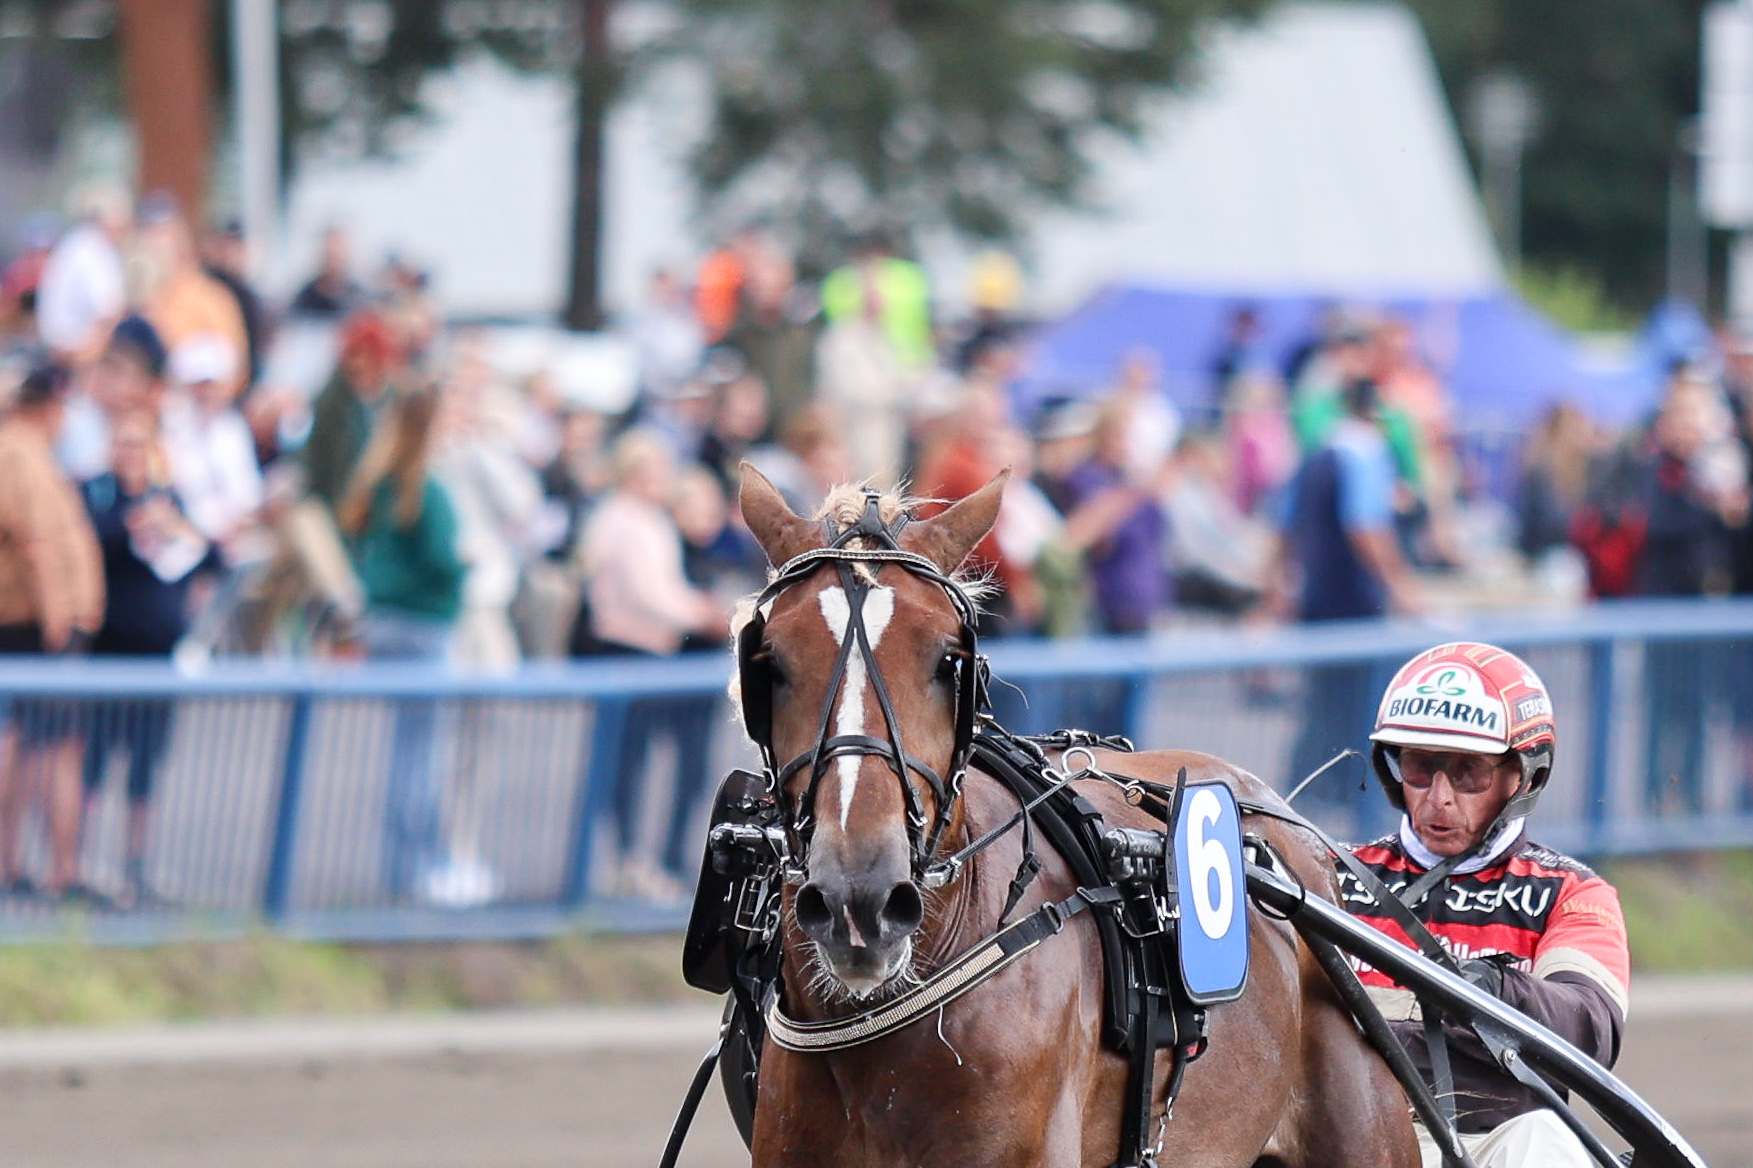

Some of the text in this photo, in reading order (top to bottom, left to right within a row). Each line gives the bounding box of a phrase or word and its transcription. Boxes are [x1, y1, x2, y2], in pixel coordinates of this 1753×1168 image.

[1389, 697, 1498, 731] BIOFARM
[1187, 789, 1234, 940] 6
[1445, 882, 1552, 918] ISKU
